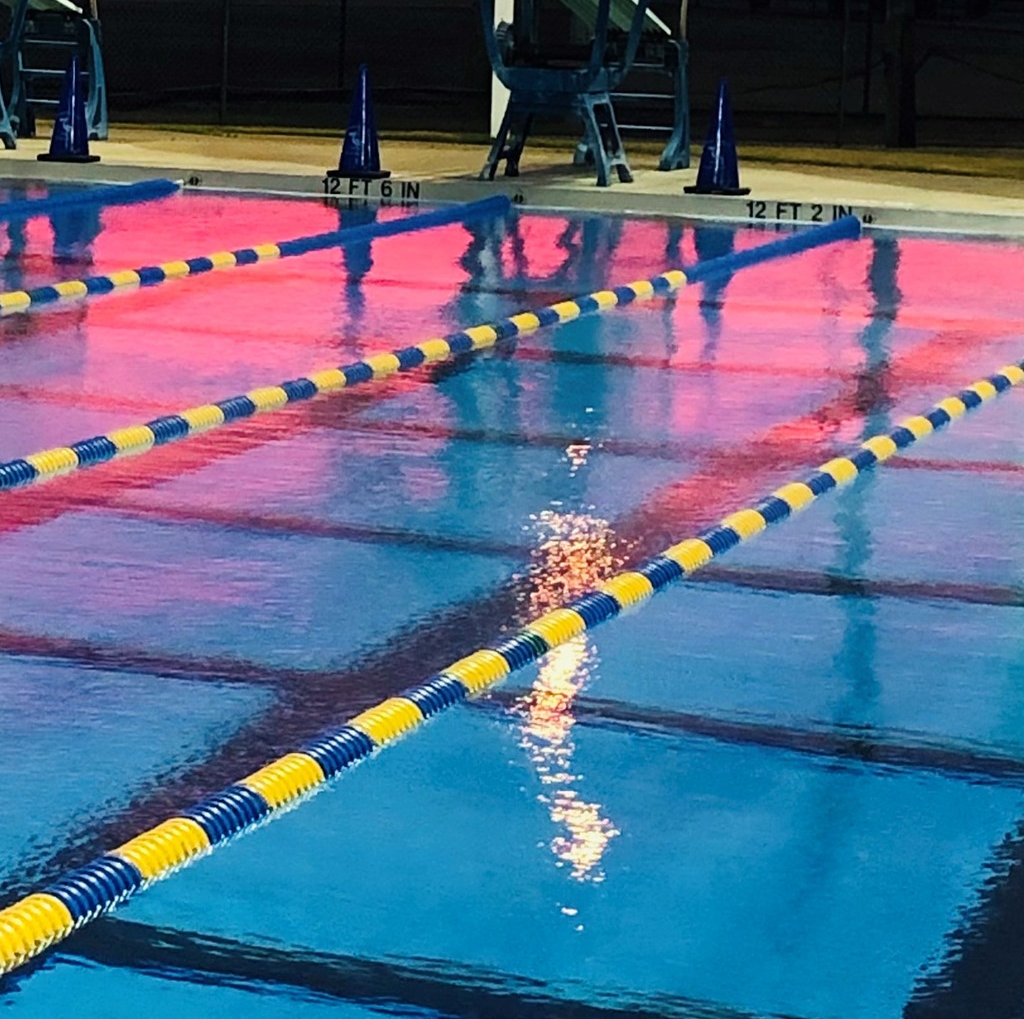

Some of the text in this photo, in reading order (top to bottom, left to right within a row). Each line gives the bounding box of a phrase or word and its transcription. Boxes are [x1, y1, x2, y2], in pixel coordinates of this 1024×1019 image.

[322, 178, 420, 199] 12 FT 6 IN
[746, 201, 853, 222] 12 FT 2 IN
